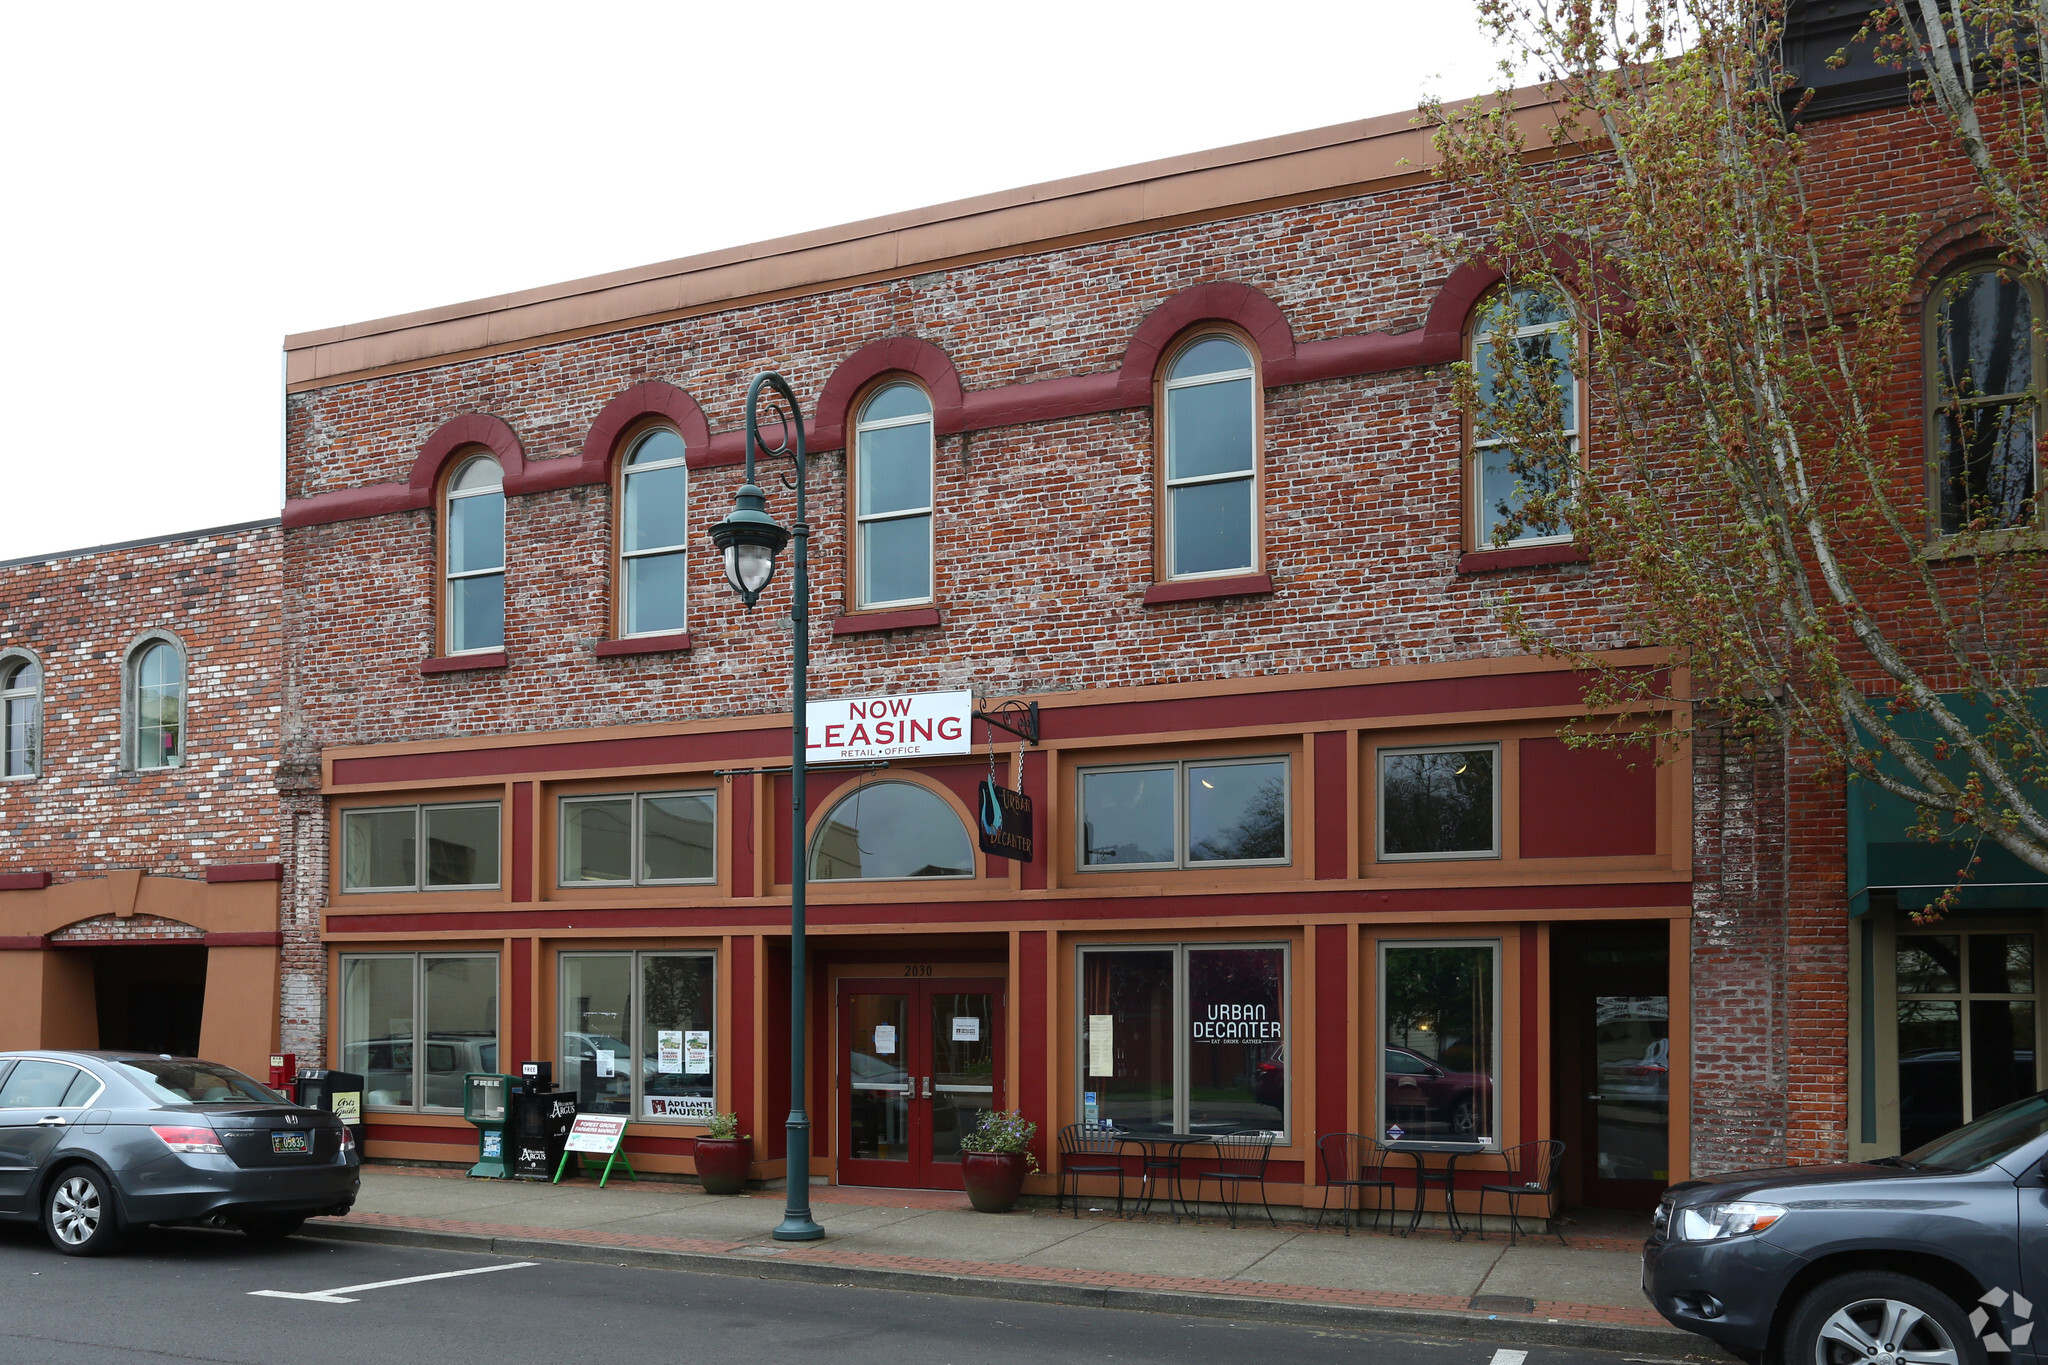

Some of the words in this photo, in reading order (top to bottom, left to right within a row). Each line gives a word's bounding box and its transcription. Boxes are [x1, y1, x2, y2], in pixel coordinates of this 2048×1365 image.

[849, 698, 913, 720] NOW
[806, 716, 962, 749] LEASING
[841, 749, 876, 758] RETAIL
[884, 746, 921, 755] OFFICE
[1002, 789, 1031, 815] URBAN
[990, 830, 1033, 858] DECANTER
[904, 965, 933, 977] 2030
[1207, 1004, 1266, 1021] URBAN
[1193, 1021, 1282, 1038] DECANTER
[337, 1098, 355, 1107] Arts
[667, 1100, 713, 1108] ADELANTE
